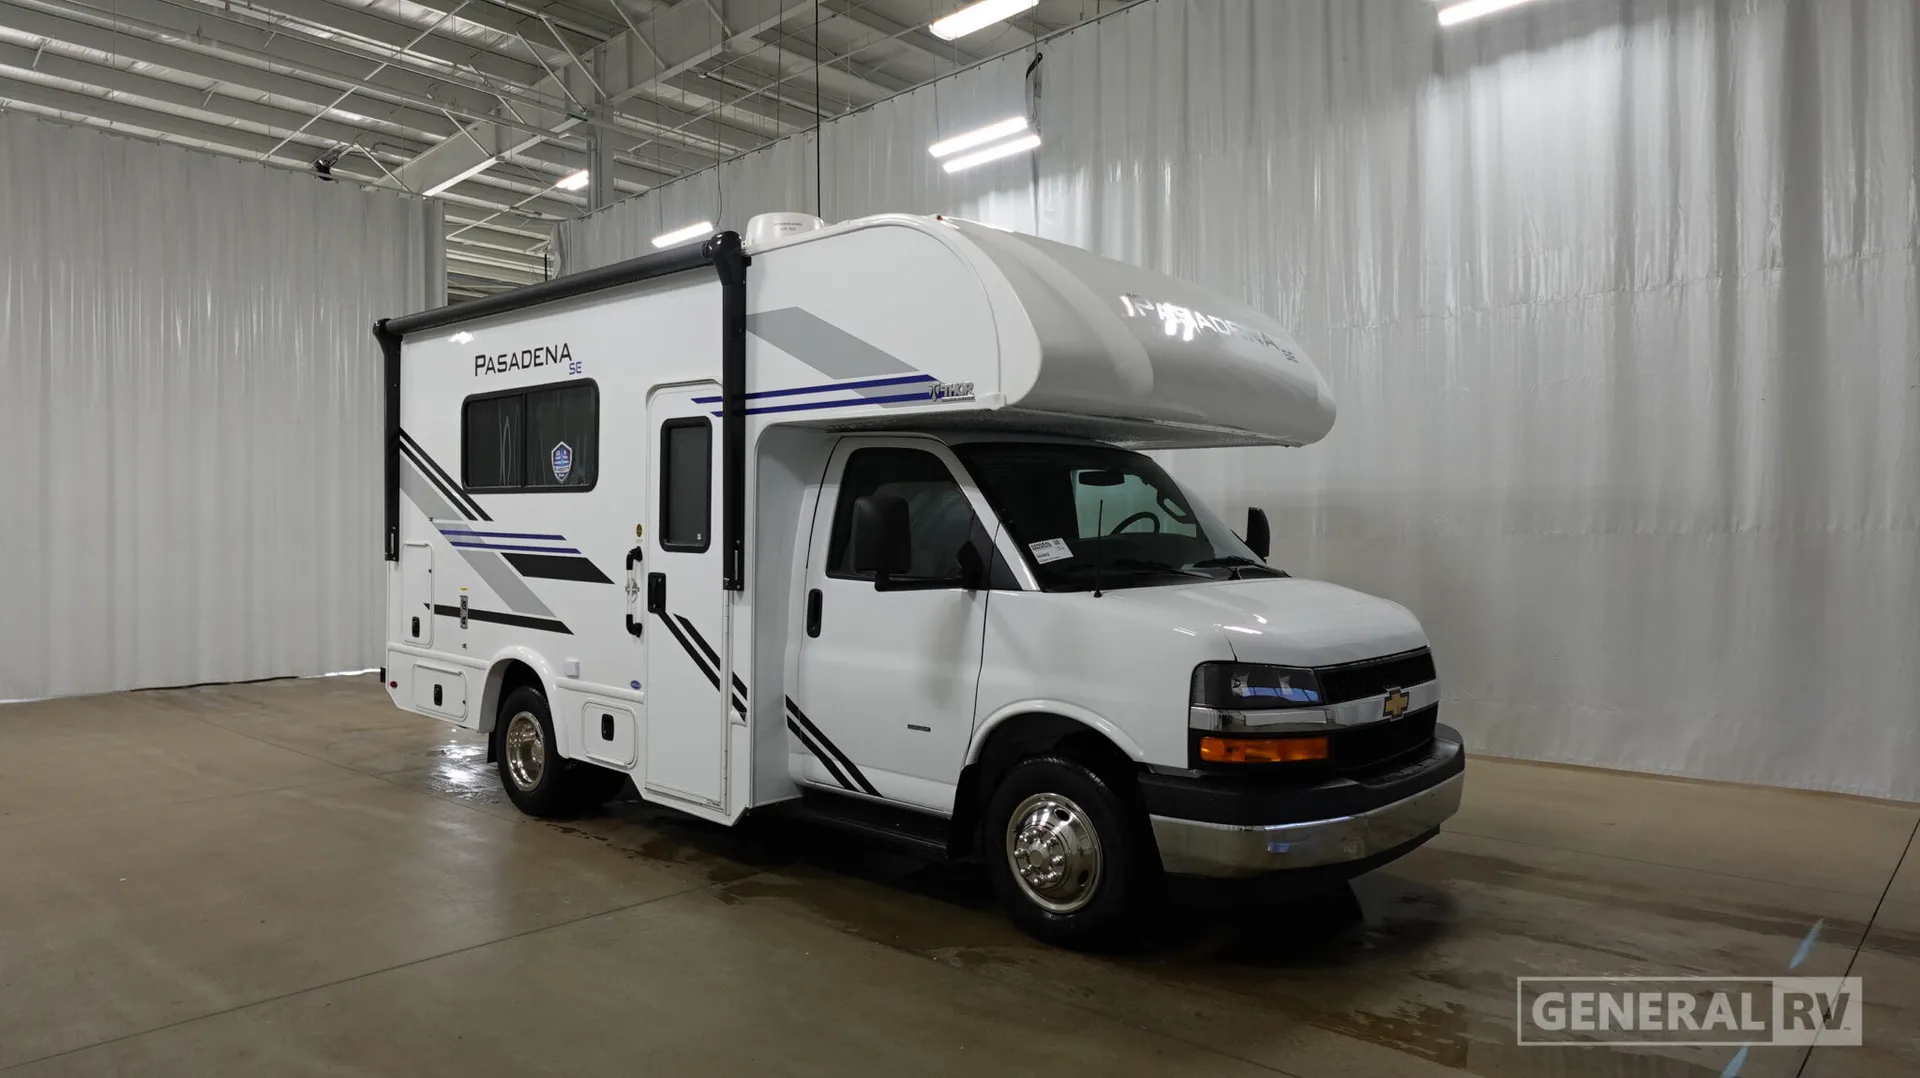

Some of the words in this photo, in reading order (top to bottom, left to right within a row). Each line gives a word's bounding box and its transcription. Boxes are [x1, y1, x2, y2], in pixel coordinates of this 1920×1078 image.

[475, 342, 573, 377] PASADENA
[569, 361, 582, 375] SE
[940, 382, 975, 397] THOR
